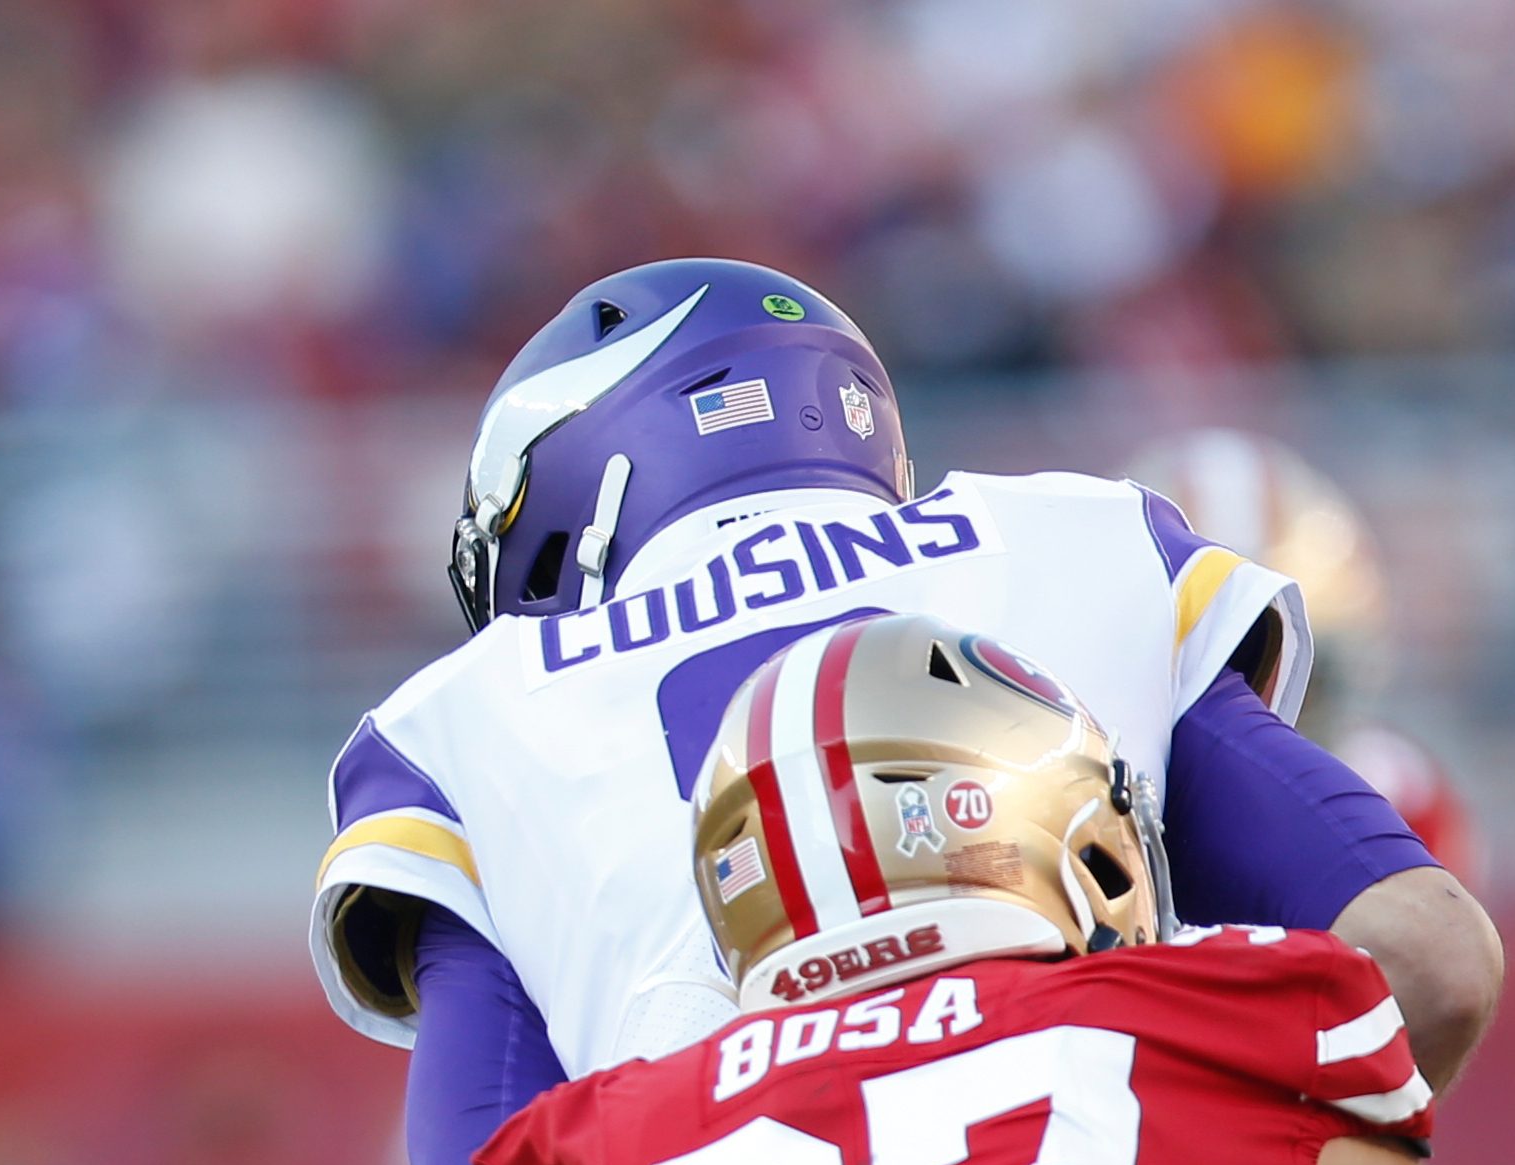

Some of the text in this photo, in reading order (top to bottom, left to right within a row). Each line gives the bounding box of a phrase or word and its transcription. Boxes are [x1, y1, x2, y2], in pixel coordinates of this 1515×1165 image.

[540, 489, 980, 673] COUSINS
[951, 789, 988, 821] 70
[771, 923, 946, 1003] 49ERS
[714, 977, 983, 1103] BOSA
